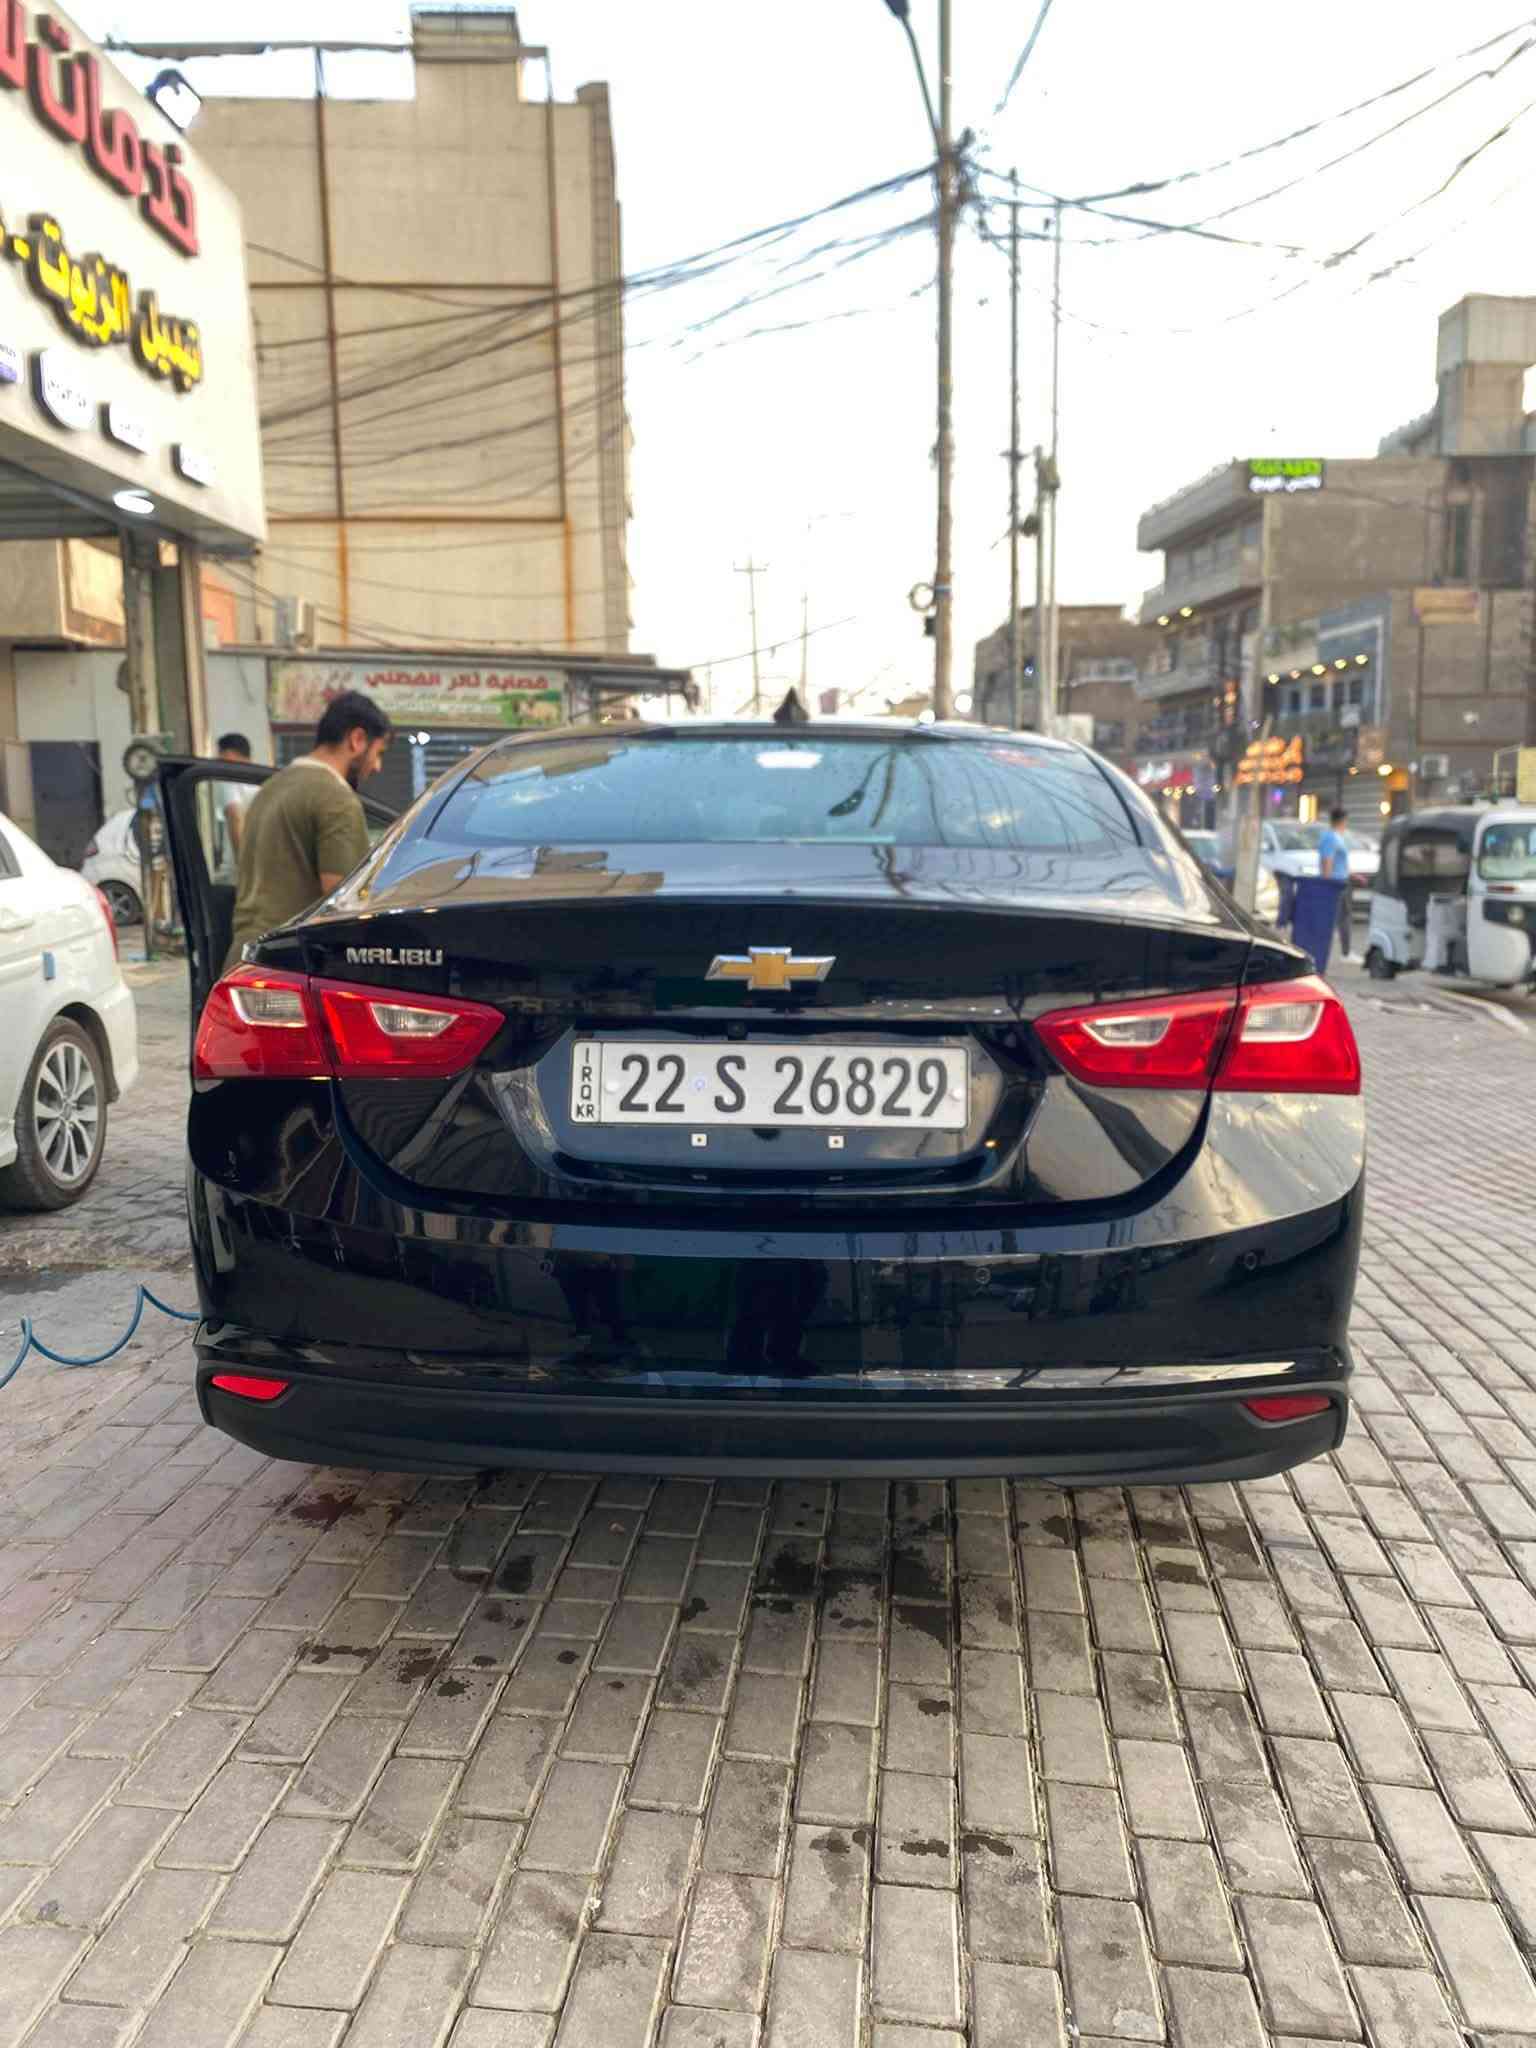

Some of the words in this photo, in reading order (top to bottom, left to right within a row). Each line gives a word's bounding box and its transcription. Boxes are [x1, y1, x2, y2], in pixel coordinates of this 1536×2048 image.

[36, 217, 131, 344] الزيوت
[345, 946, 443, 967] MALIBU
[619, 1055, 686, 1113] 22
[714, 1055, 747, 1113] S
[773, 1056, 949, 1118] 26829
[575, 1103, 595, 1119] KR
